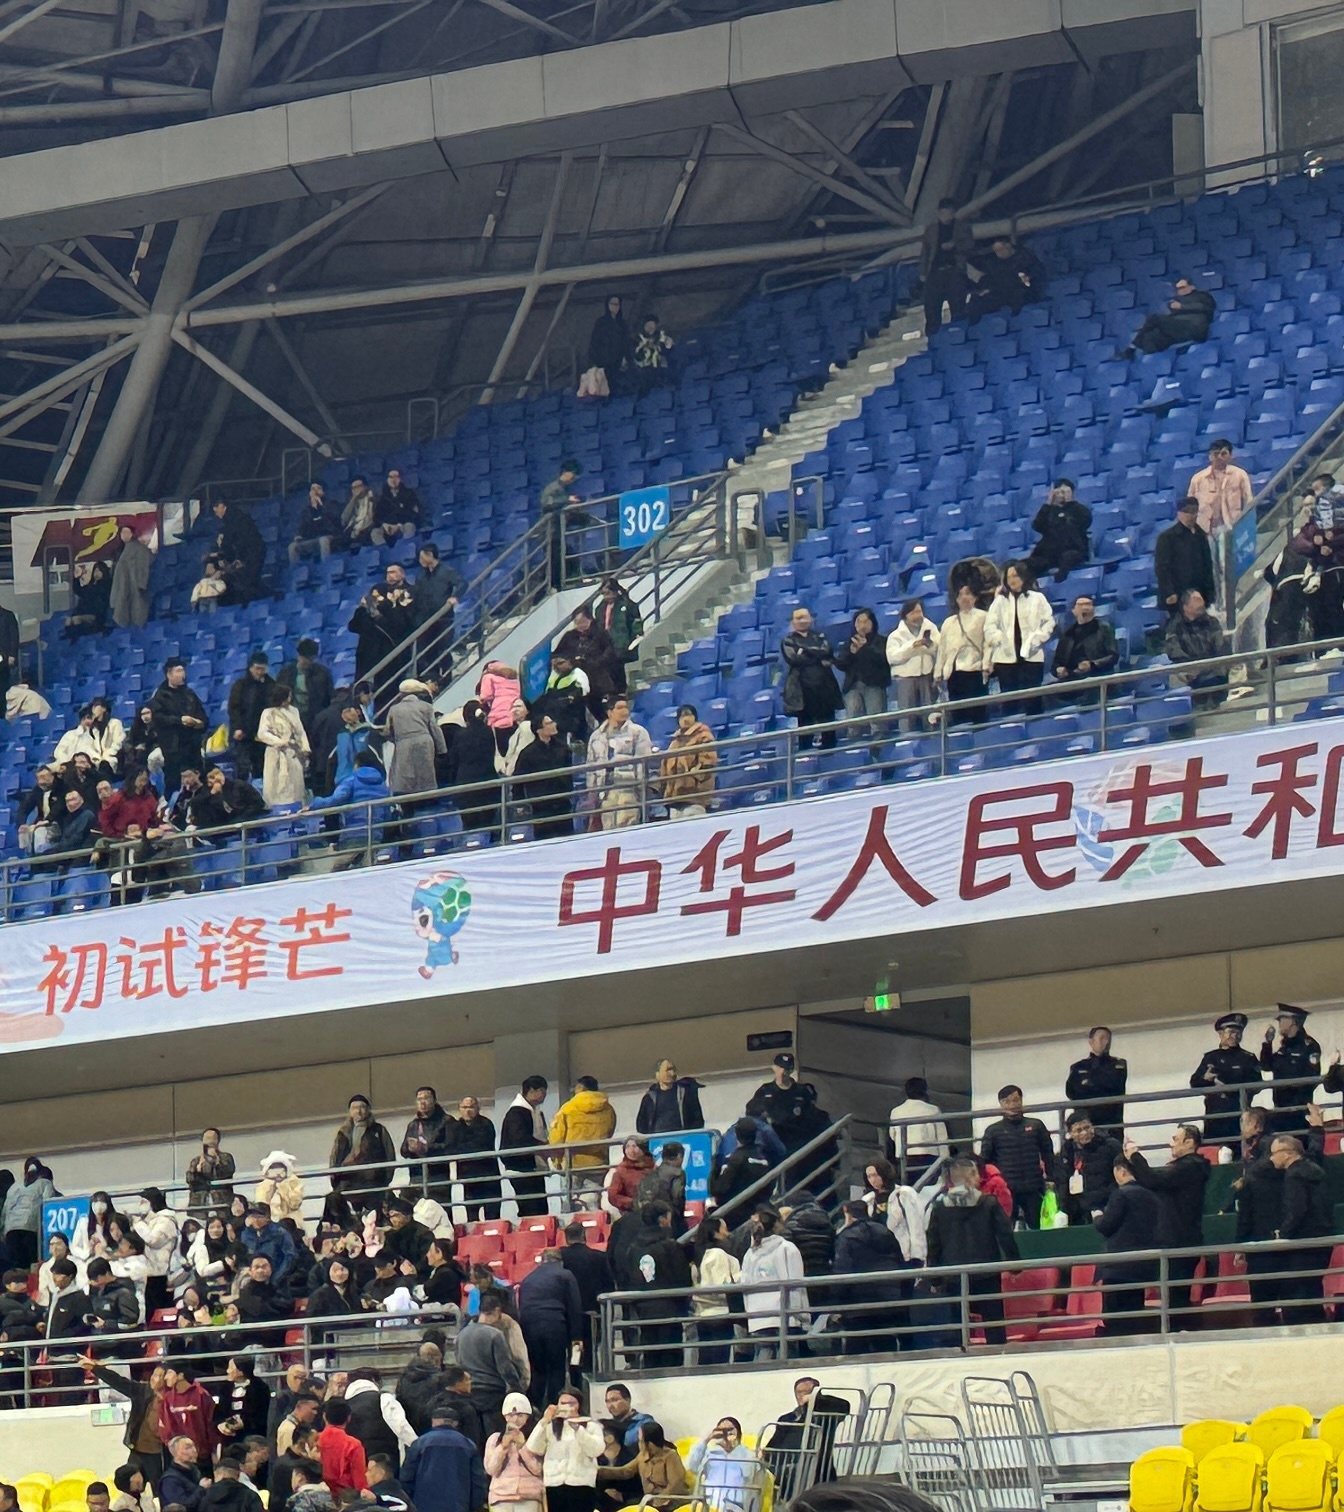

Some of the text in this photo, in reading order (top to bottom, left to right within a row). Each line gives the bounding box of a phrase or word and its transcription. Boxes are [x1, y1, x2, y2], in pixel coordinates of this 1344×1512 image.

[623, 501, 666, 536] 302
[38, 902, 354, 1017] 初试锋芒
[47, 1207, 78, 1233] 207
